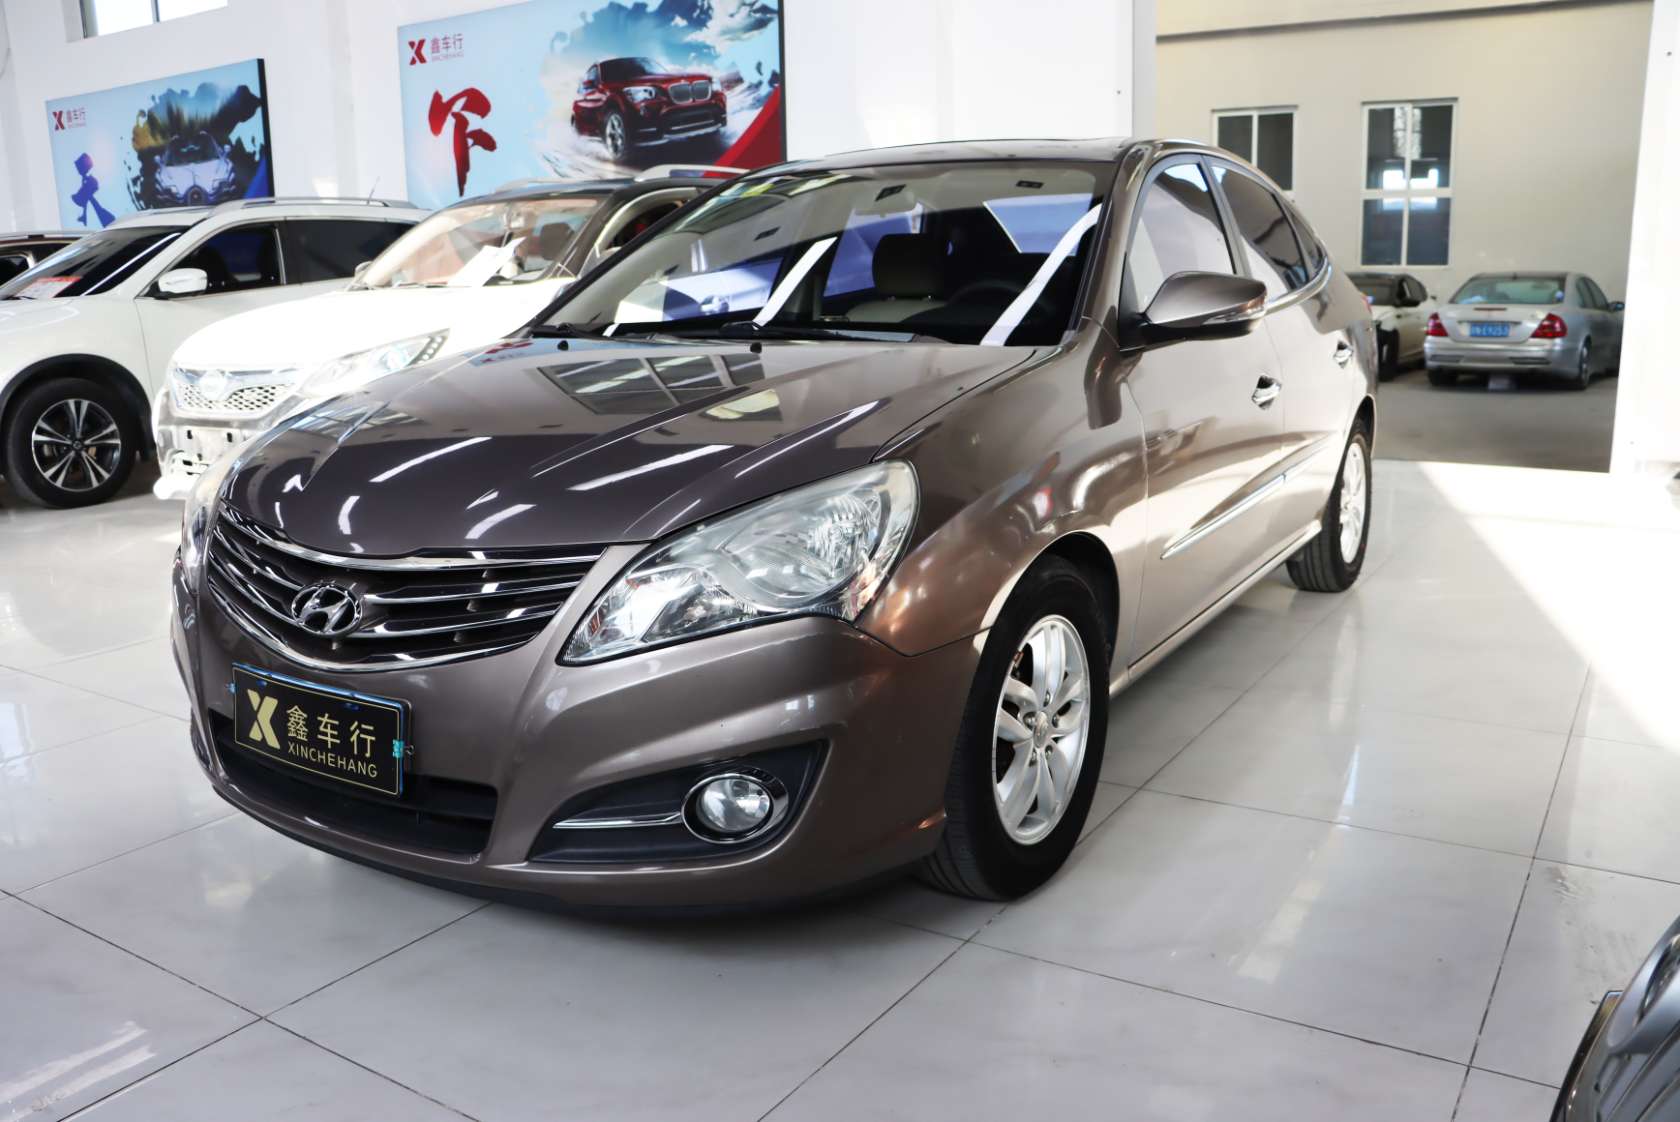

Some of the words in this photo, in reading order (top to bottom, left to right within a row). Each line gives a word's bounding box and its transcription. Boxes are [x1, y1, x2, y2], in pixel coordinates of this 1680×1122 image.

[286, 705, 377, 759] 鑫车行
[287, 741, 378, 778] XINCHEHANG
